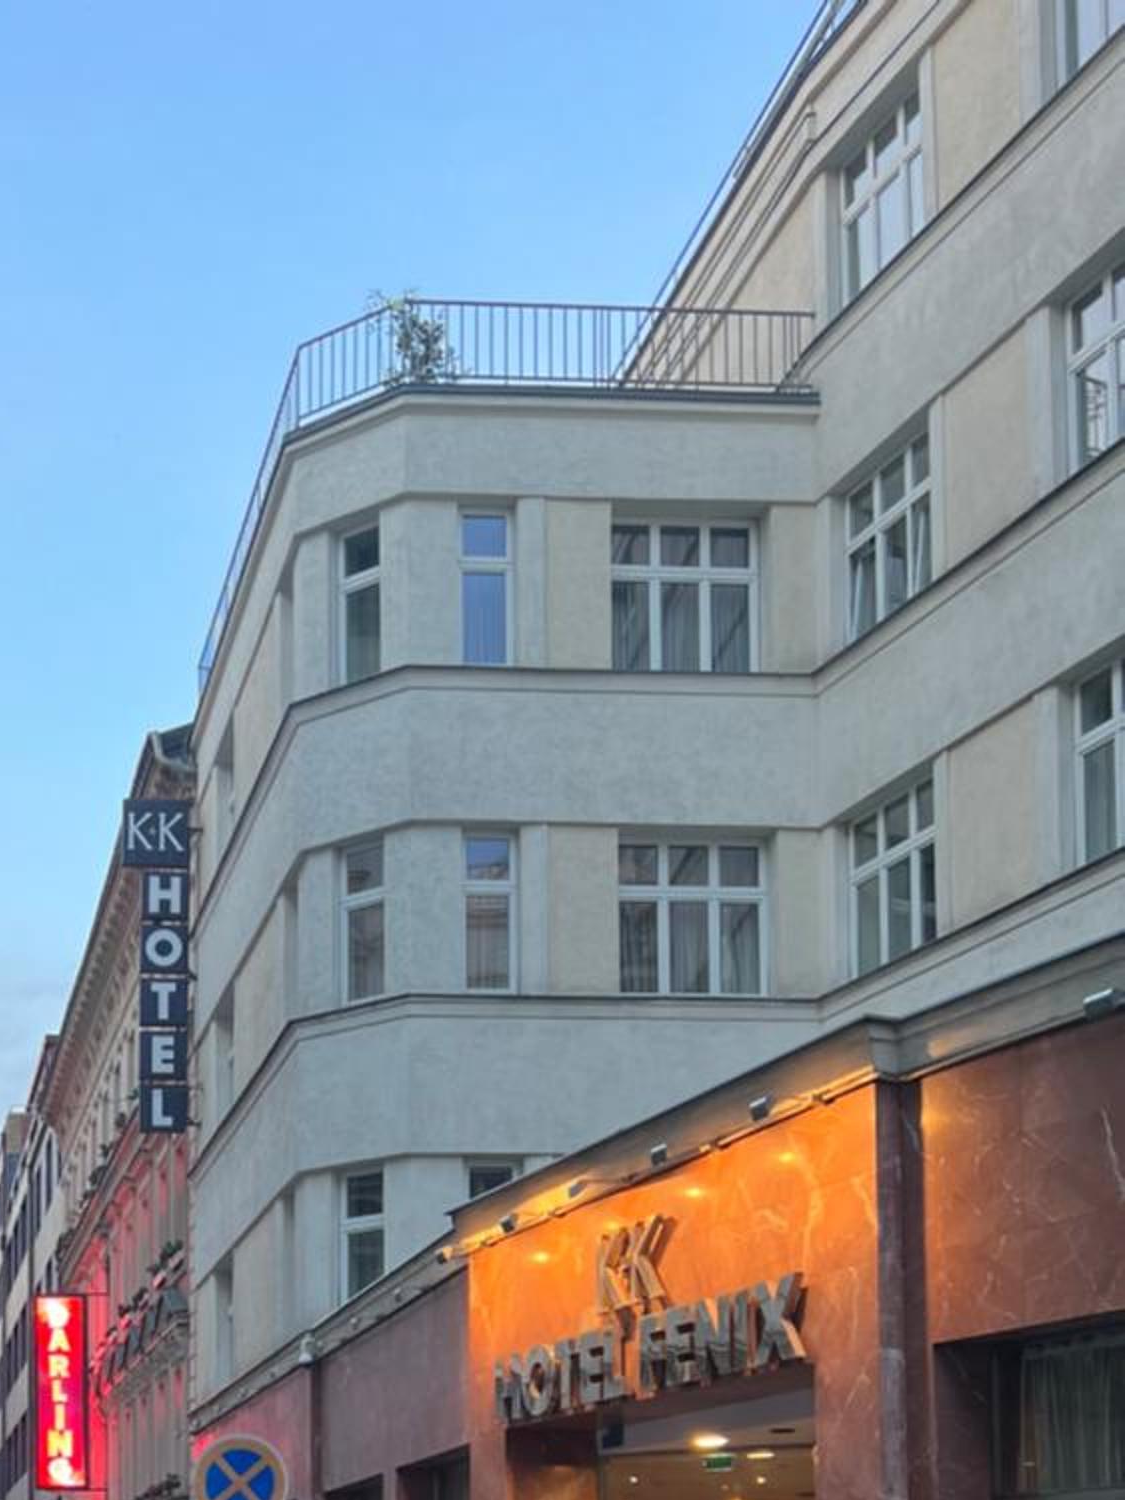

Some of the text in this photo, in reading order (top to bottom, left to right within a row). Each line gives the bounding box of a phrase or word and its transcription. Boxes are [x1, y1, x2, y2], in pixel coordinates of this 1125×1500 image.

[145, 875, 183, 1127] HOTEL
[46, 1298, 75, 1484] DARLING
[494, 1272, 808, 1424] HOTEL FENIX
